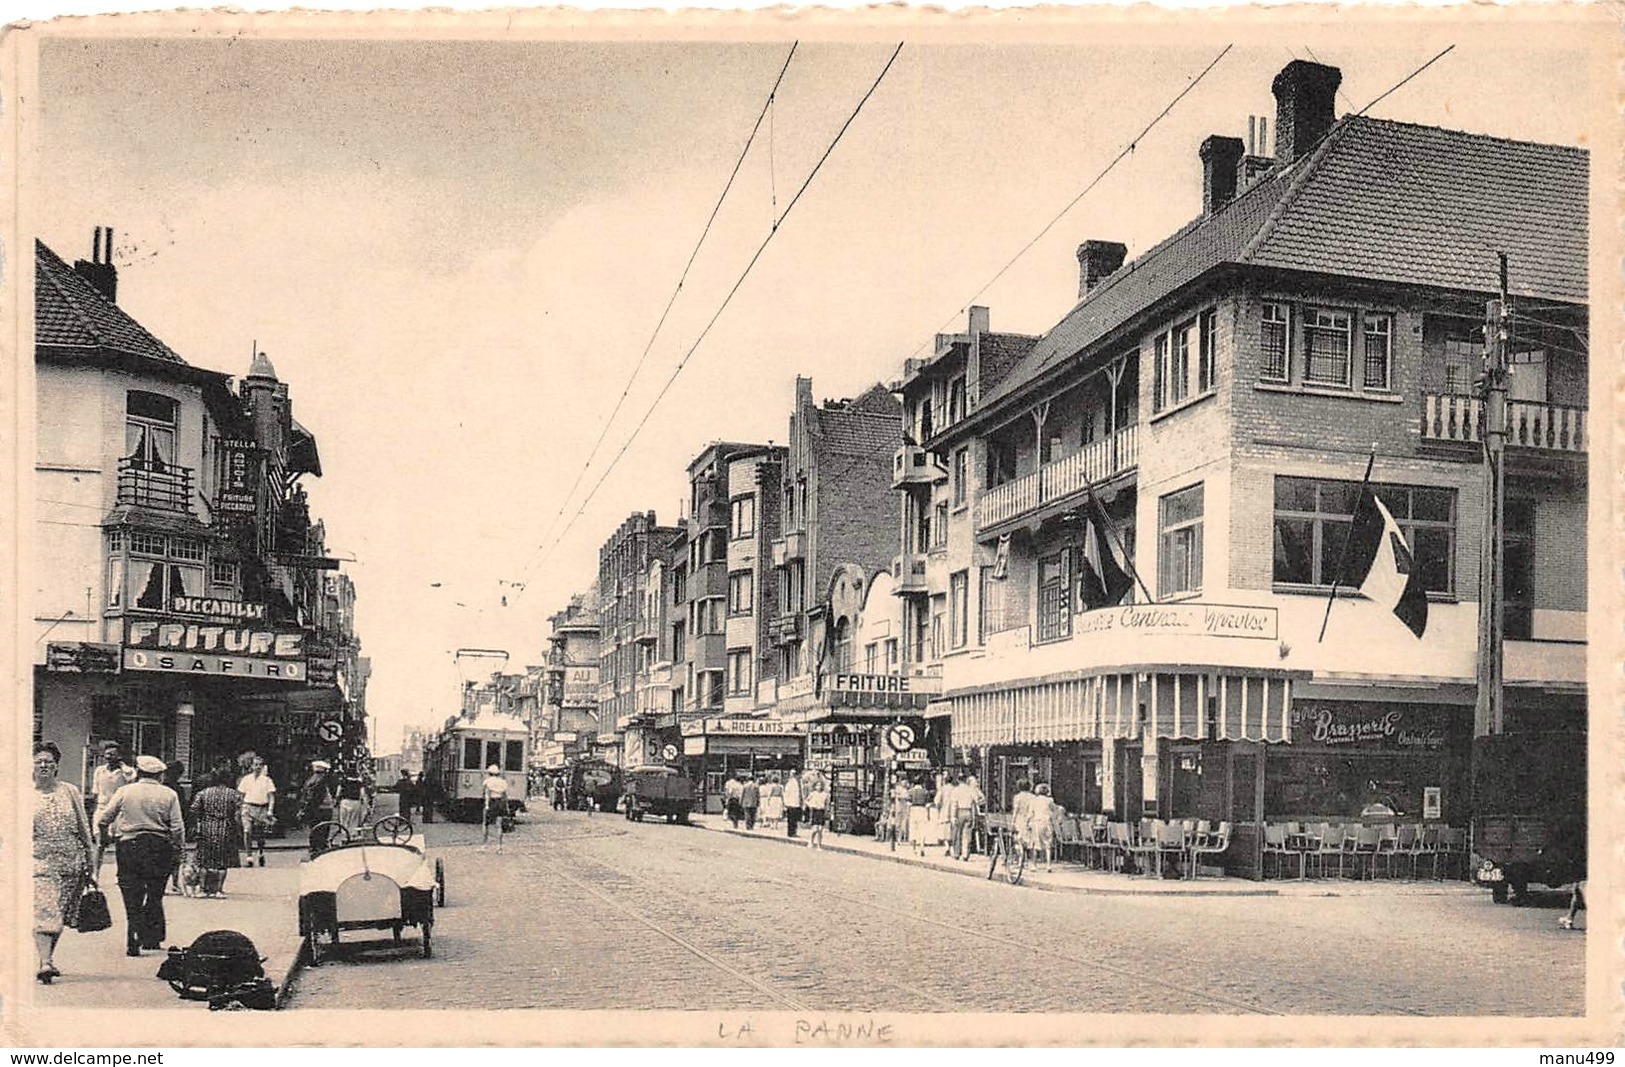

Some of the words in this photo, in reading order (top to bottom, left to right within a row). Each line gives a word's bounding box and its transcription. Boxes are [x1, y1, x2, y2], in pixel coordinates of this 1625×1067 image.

[223, 440, 256, 448] STELLA
[174, 597, 265, 619] PICCADILLY
[130, 621, 302, 656] FRITURE
[160, 656, 281, 676] SAFIR
[837, 675, 910, 691] FRITURE
[731, 721, 784, 733] ROELANTS
[718, 1021, 755, 1039] LA
[794, 1019, 894, 1044] PANNE
